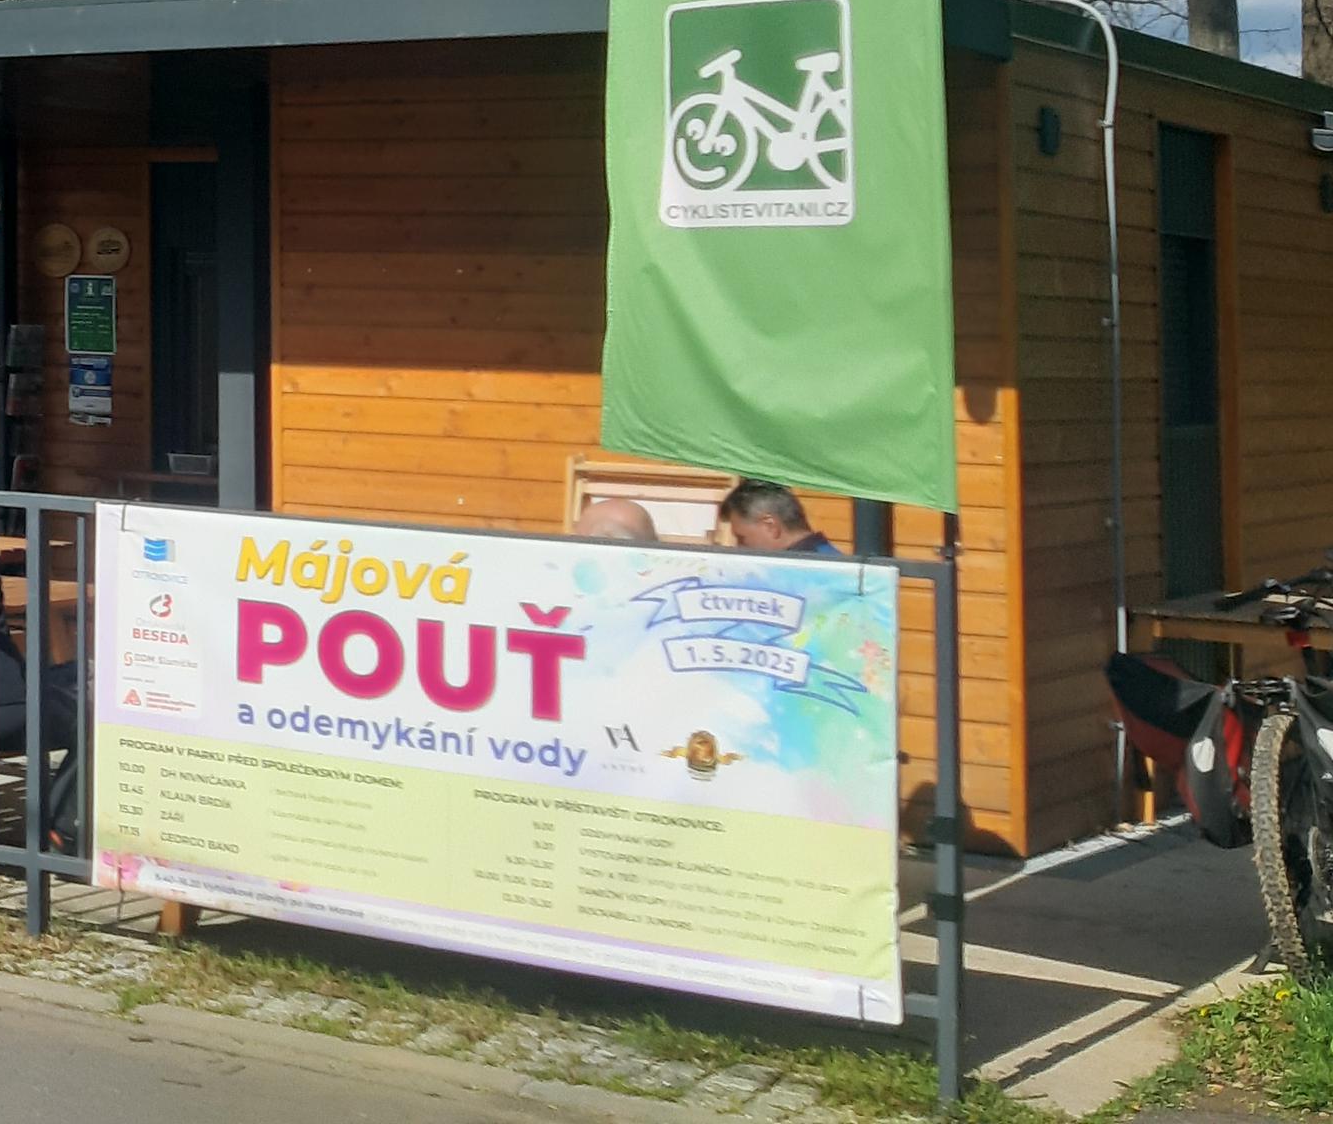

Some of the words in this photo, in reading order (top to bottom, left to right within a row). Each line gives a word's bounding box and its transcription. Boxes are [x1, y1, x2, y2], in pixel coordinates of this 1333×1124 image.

[666, 201, 850, 220] CYKLISTEVITANI.CZ
[236, 535, 472, 605] Májová
[700, 592, 784, 617] čtvrtek
[132, 627, 190, 645] BESEDA
[237, 598, 587, 722] POUŤ
[740, 646, 796, 675] 2025
[237, 703, 255, 725] a
[267, 704, 477, 757] odemykání
[488, 737, 587, 777] vody
[119, 737, 174, 754] PROGRAM
[186, 748, 226, 762] PARKU
[228, 752, 260, 768] PŘED
[261, 758, 351, 782] SPOLEČENSKÝM
[474, 788, 538, 807] PROGRAM
[207, 839, 240, 854] BAND
